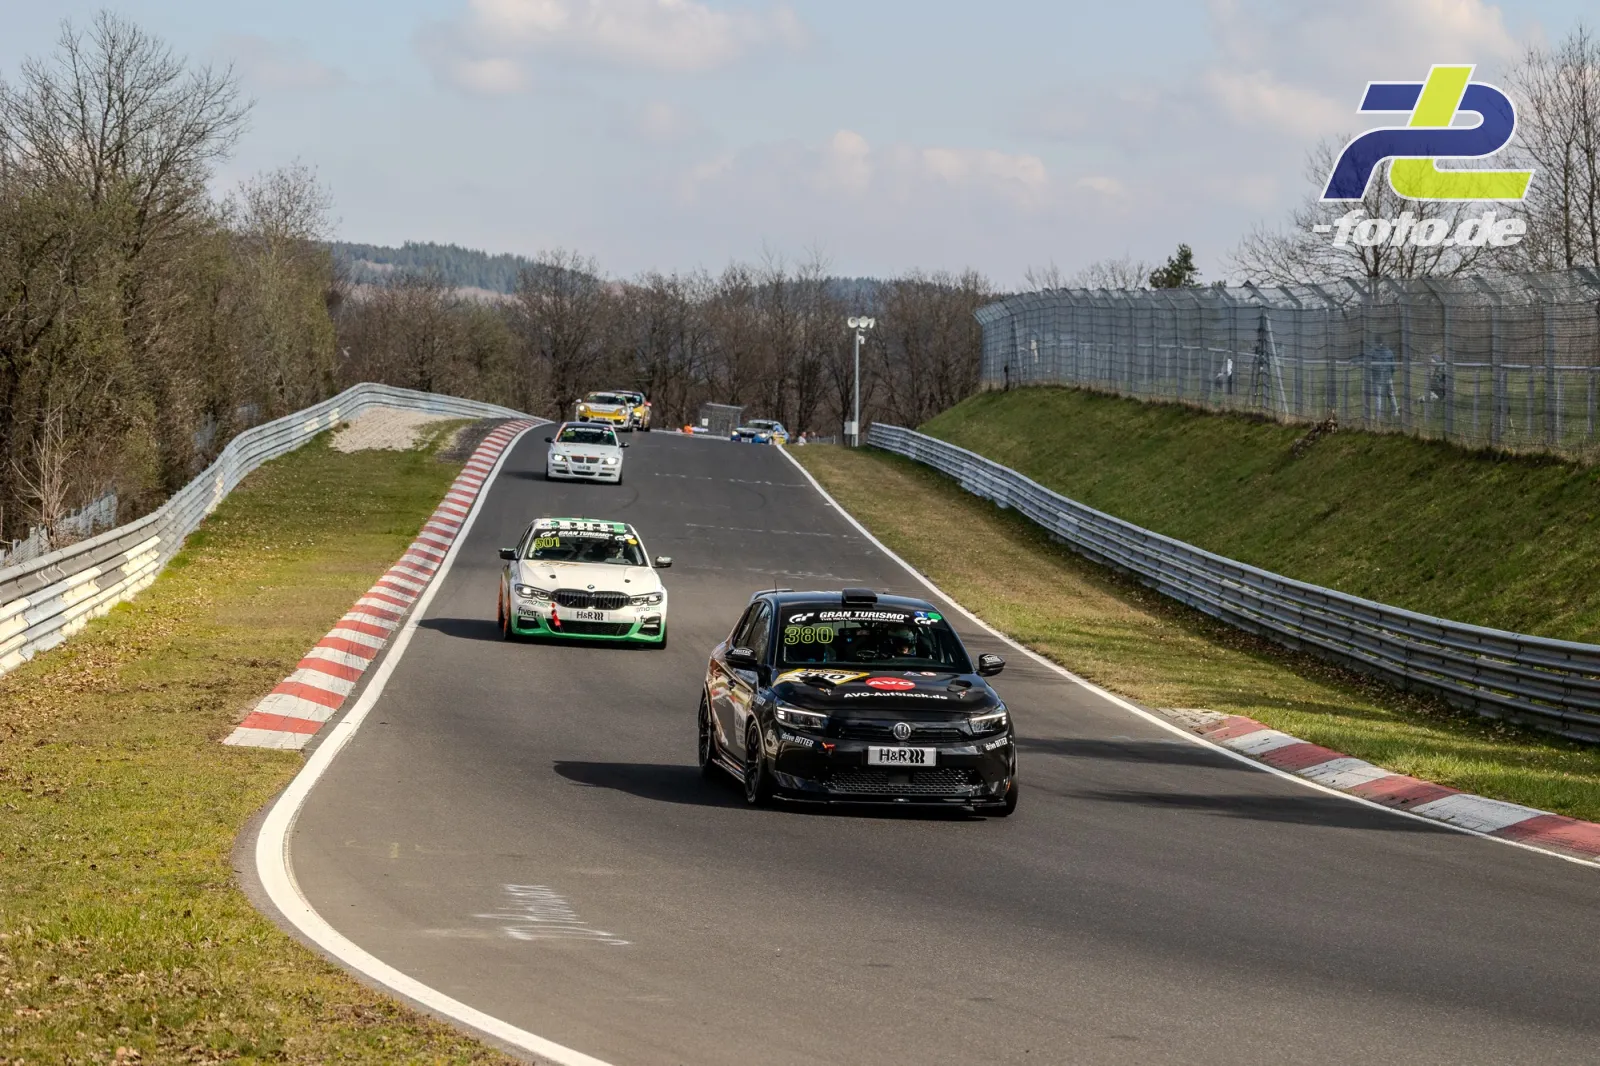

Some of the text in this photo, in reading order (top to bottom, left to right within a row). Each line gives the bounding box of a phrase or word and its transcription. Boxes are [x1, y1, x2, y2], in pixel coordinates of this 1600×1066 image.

[854, 611, 905, 620] TURISMO
[784, 626, 834, 645] 380
[868, 679, 915, 687] AVO
[781, 733, 815, 748] drive BITTER
[879, 748, 907, 762] H&R
